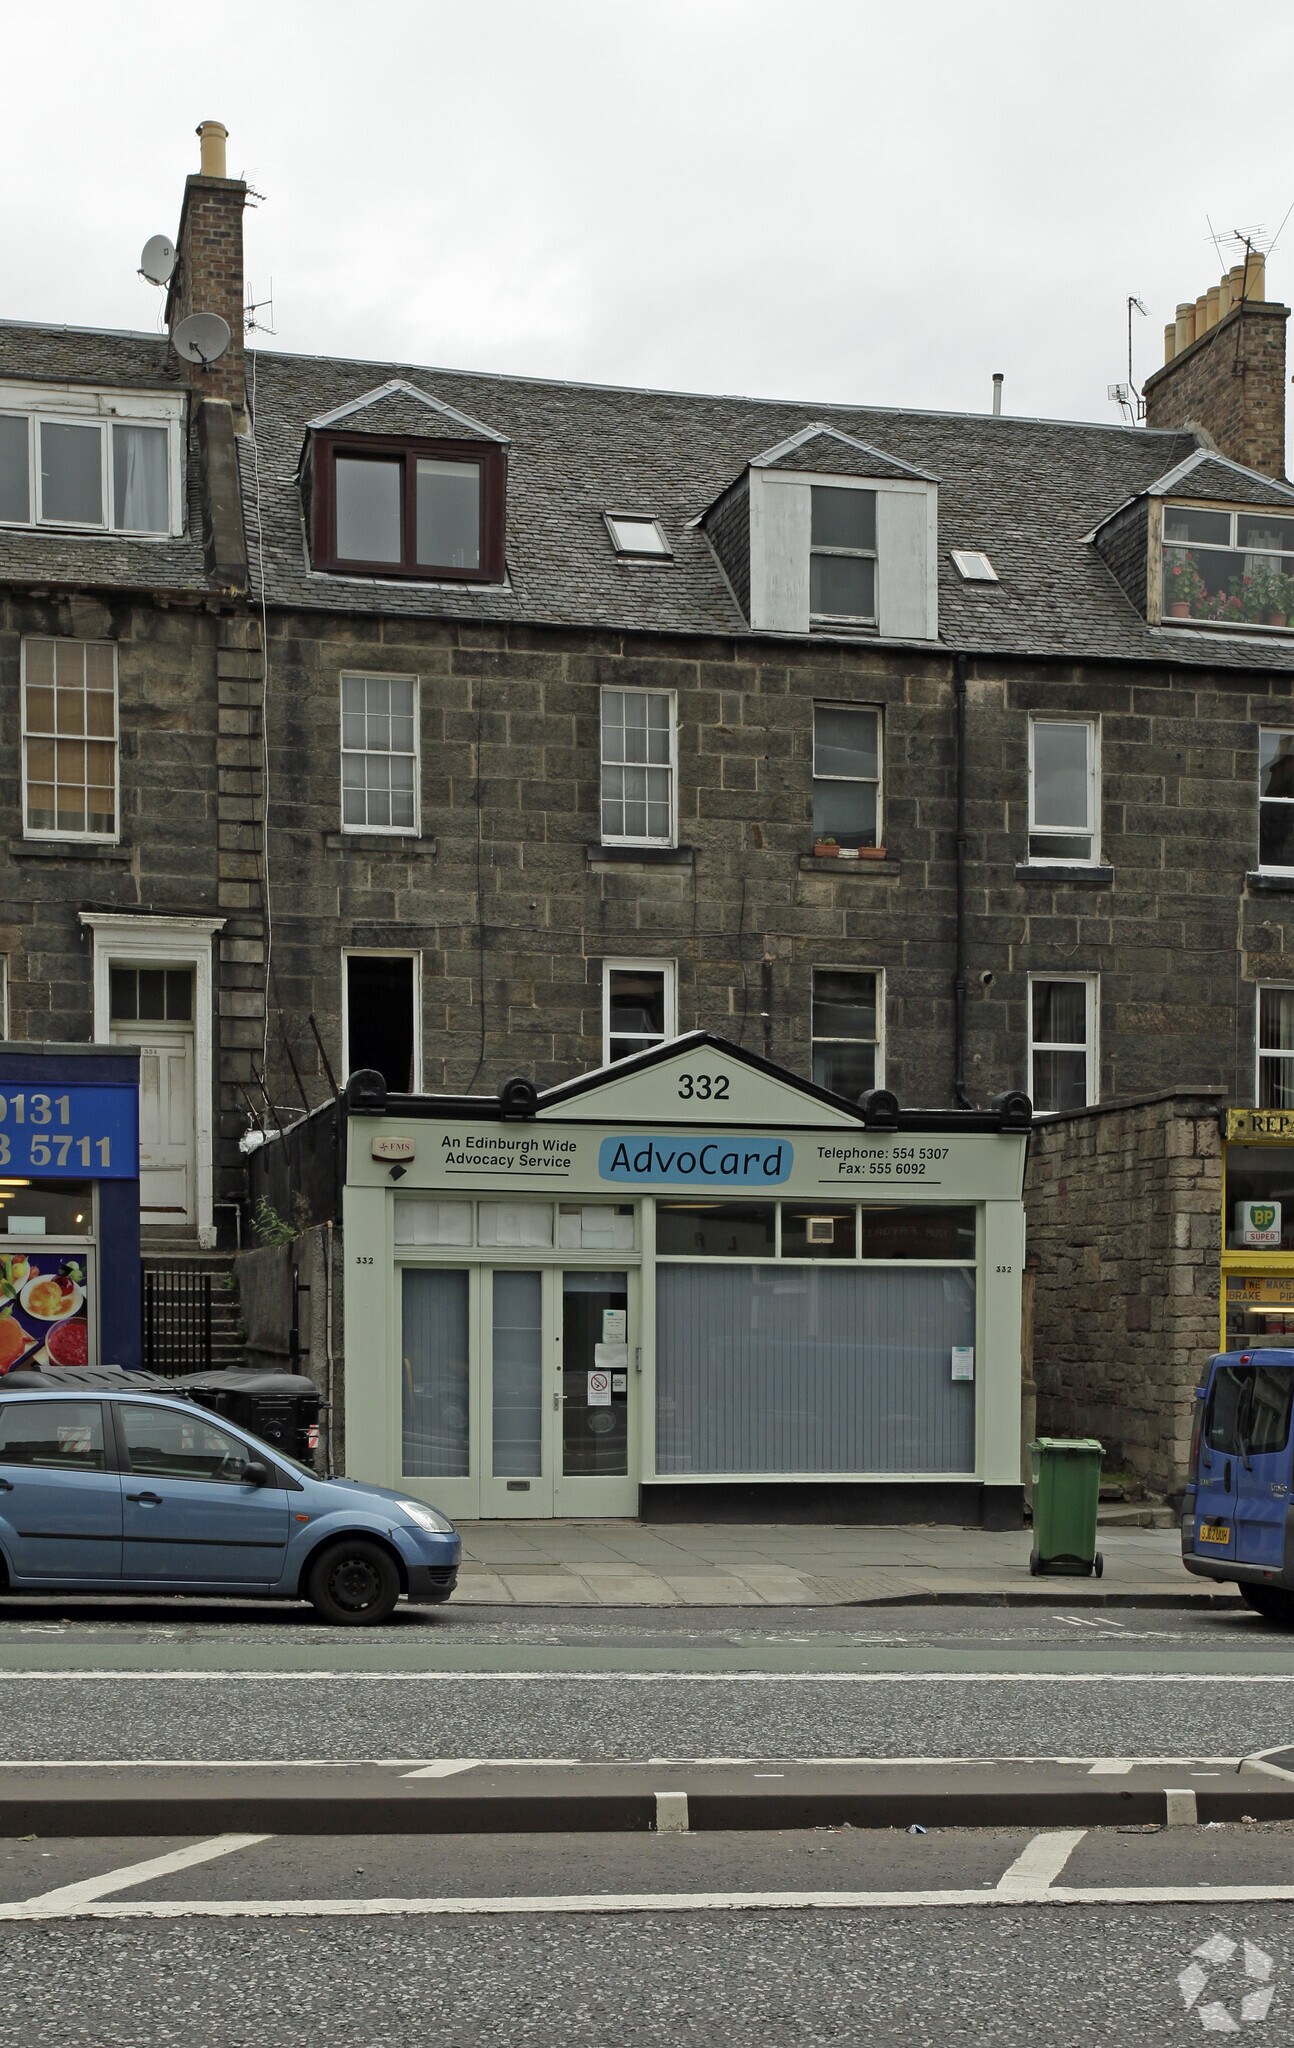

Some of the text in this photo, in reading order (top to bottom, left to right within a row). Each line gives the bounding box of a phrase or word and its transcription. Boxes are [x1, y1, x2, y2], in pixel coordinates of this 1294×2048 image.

[678, 1074, 730, 1100] 332
[29, 1134, 110, 1167] 5711
[441, 1135, 577, 1153] An Edinburgh Wide
[445, 1152, 571, 1169] Advocacy Service
[610, 1142, 782, 1176] AdvoCard
[817, 1147, 949, 1161] Telephone: 554 5307
[838, 1162, 926, 1175] Fax: 555 6092
[1254, 1210, 1274, 1225] BP
[1250, 1233, 1276, 1241] SUPER
[356, 1256, 374, 1265] 332
[996, 1265, 1012, 1273] 332
[1248, 1280, 1292, 1290] WE MAKE
[1228, 1291, 1261, 1301] BRAKE
